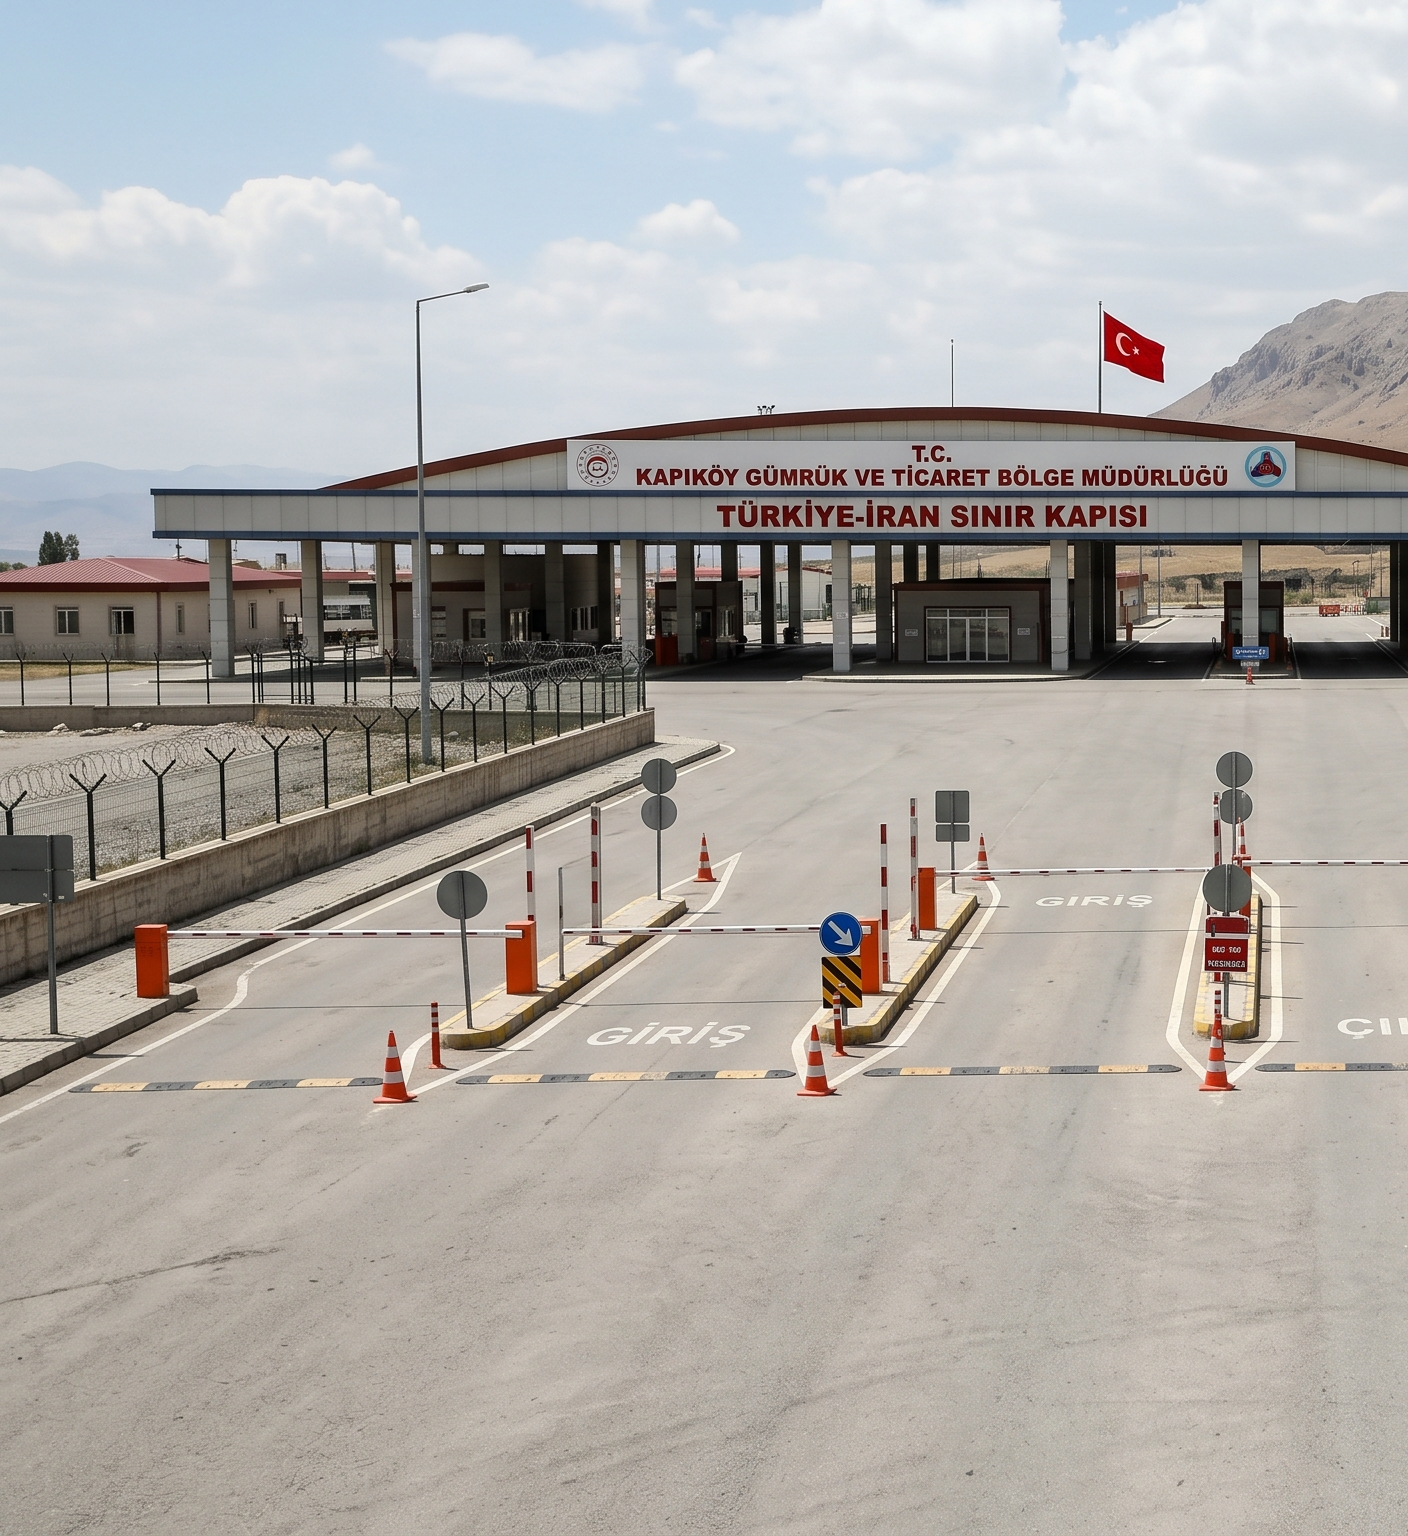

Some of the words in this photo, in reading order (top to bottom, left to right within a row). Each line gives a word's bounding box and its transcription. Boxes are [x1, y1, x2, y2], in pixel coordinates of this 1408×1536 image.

[912, 445, 952, 463] T.C.
[636, 464, 739, 486] KAPIKÖY
[746, 464, 848, 486] GÜMRÜK
[855, 469, 885, 486] VE
[892, 465, 990, 487] TİCARET
[997, 465, 1074, 487] BÖLGE
[1081, 465, 1229, 487] MÜDÜRLÜĞÜ
[716, 499, 940, 528] TÜRKİYE-İRAN
[950, 505, 1036, 528] SINIR
[1045, 505, 1148, 528] KAPISI
[586, 1021, 751, 1049] GİRİŞ
